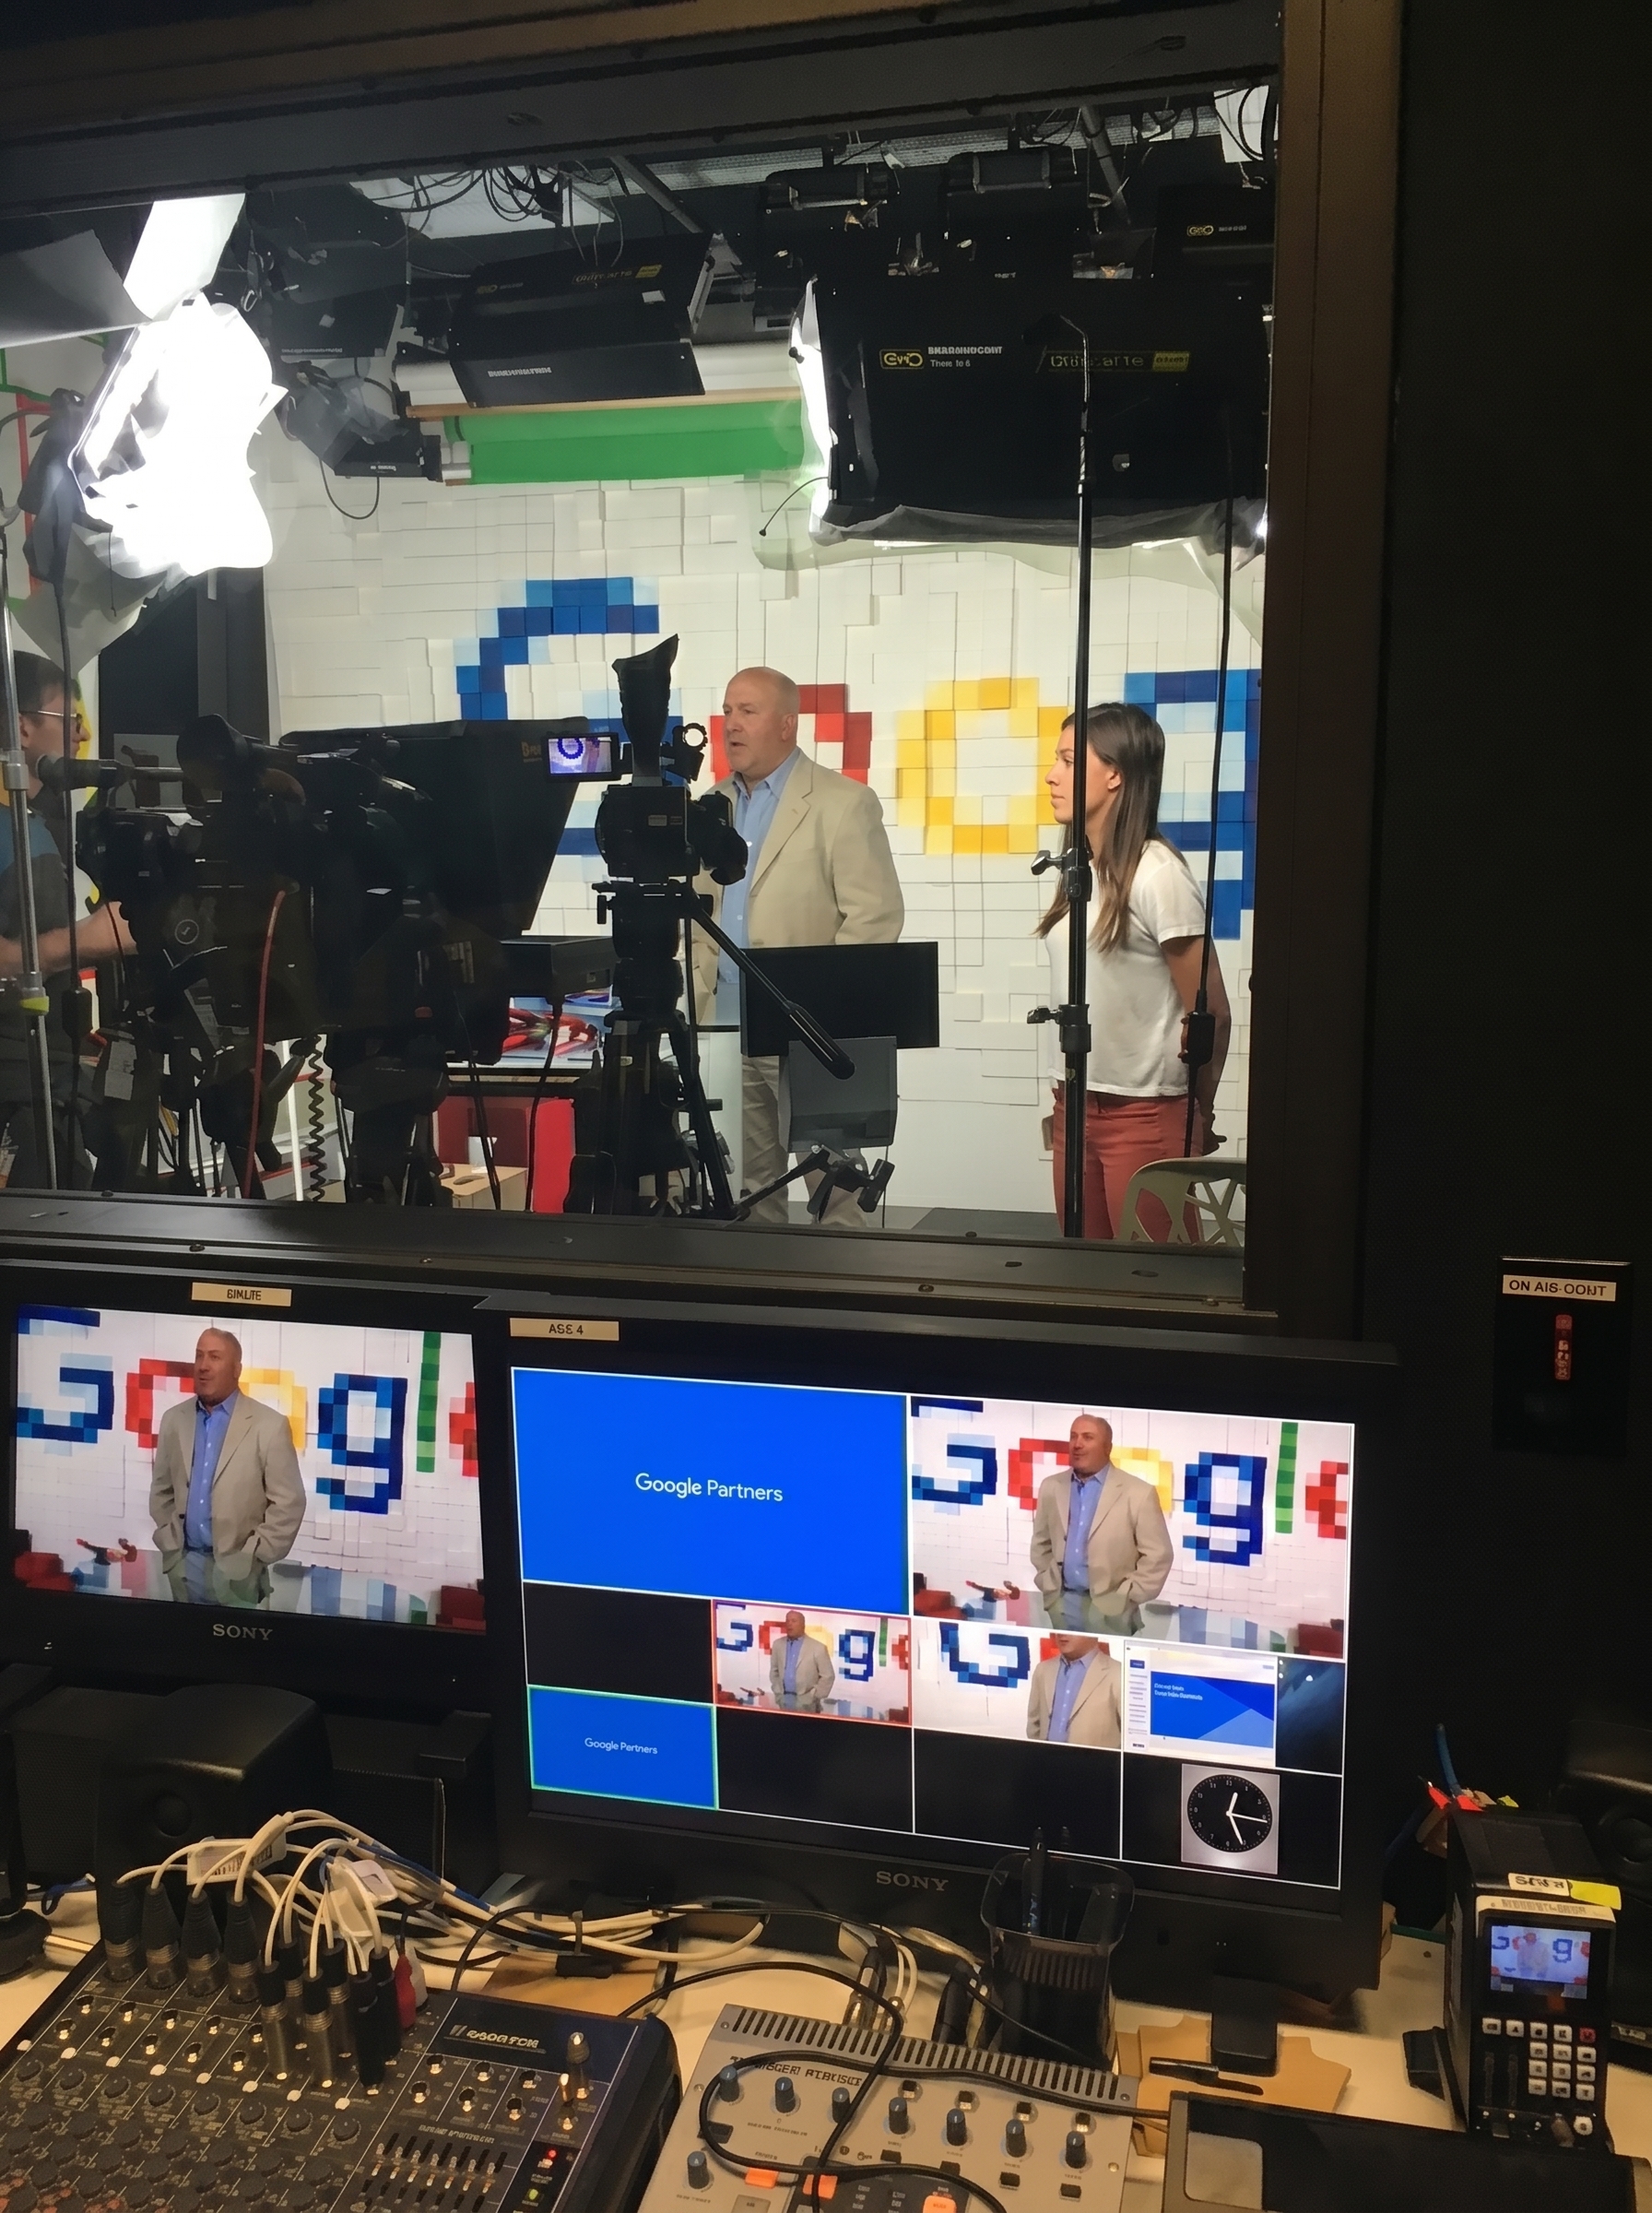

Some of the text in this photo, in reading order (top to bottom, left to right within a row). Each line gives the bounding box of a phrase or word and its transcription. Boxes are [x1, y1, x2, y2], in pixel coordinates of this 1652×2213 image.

[1508, 1279, 1530, 1292] ON
[576, 1324, 584, 1335] 4
[635, 1472, 784, 1503] Google Partners
[212, 1623, 273, 1641] SONY
[584, 1737, 619, 1752] Google
[876, 1870, 950, 1892] SONY
